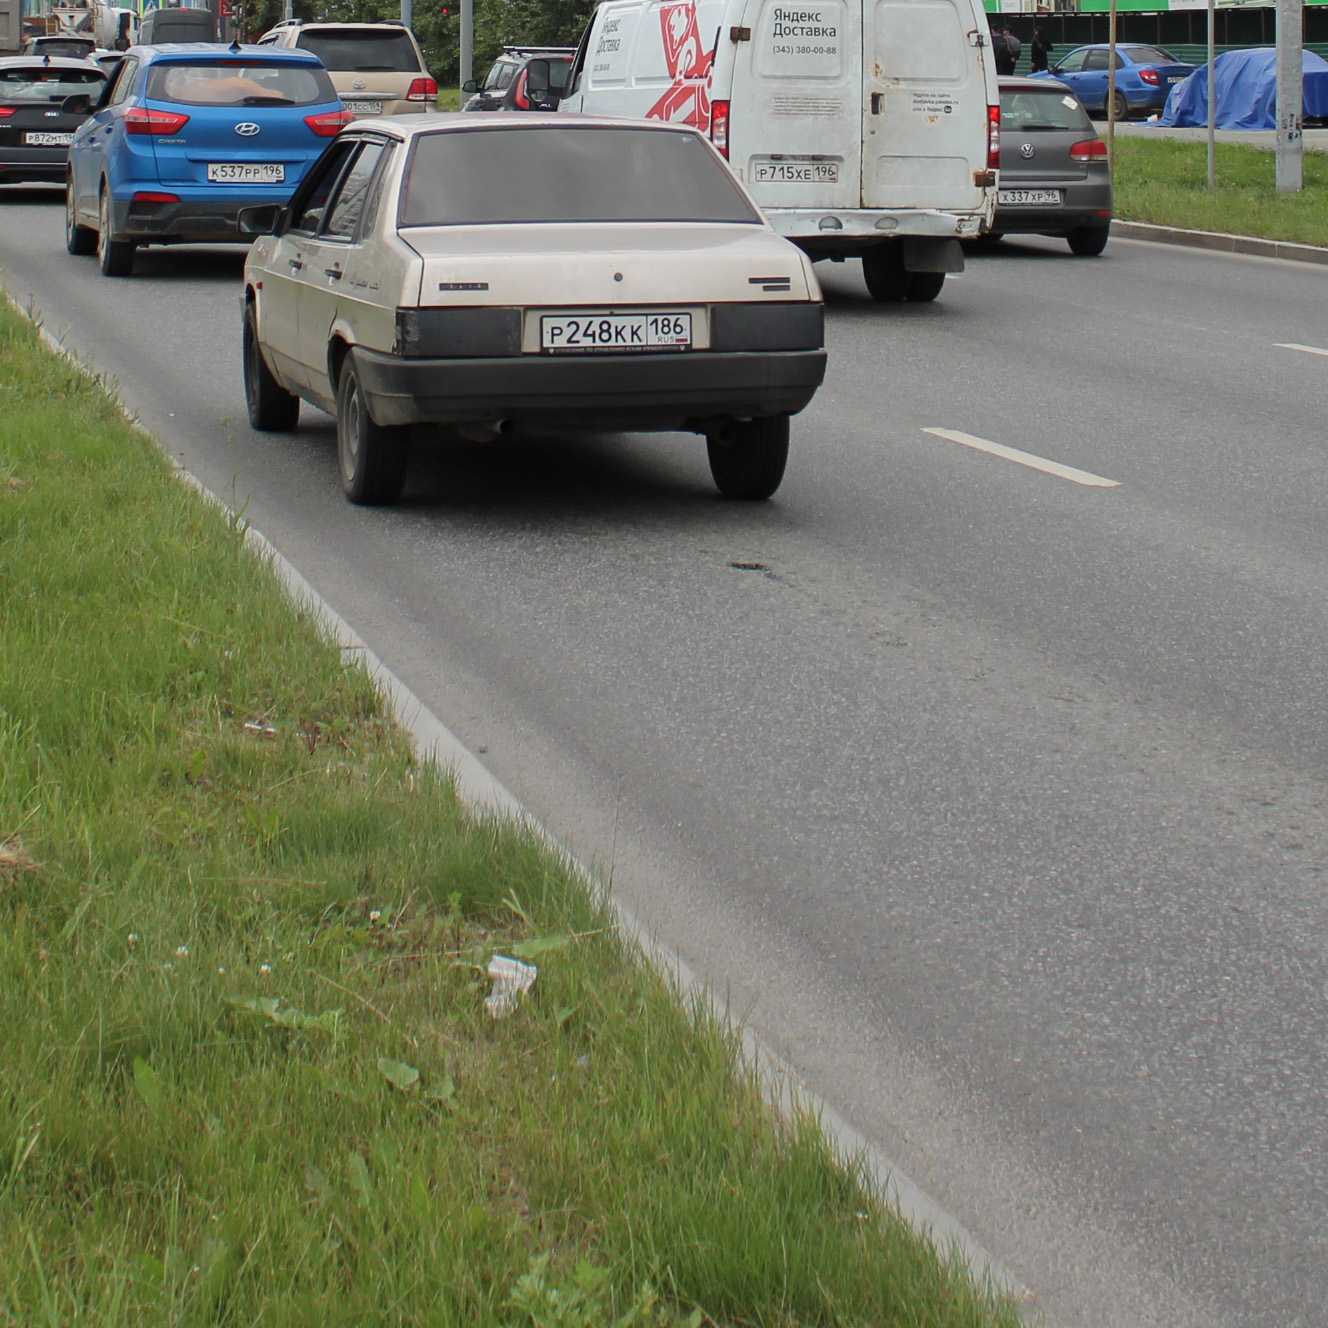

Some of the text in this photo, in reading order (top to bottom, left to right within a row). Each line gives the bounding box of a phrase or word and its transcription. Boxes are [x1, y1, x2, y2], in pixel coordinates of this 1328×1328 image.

[773, 8, 822, 23] Яндекс
[772, 23, 837, 38] Доставка
[772, 45, 837, 55] (343) 380-00-88
[212, 165, 281, 178] К537РР 196
[759, 165, 834, 180] Р715ХЕ 196
[550, 317, 684, 344] Р248КК 186
